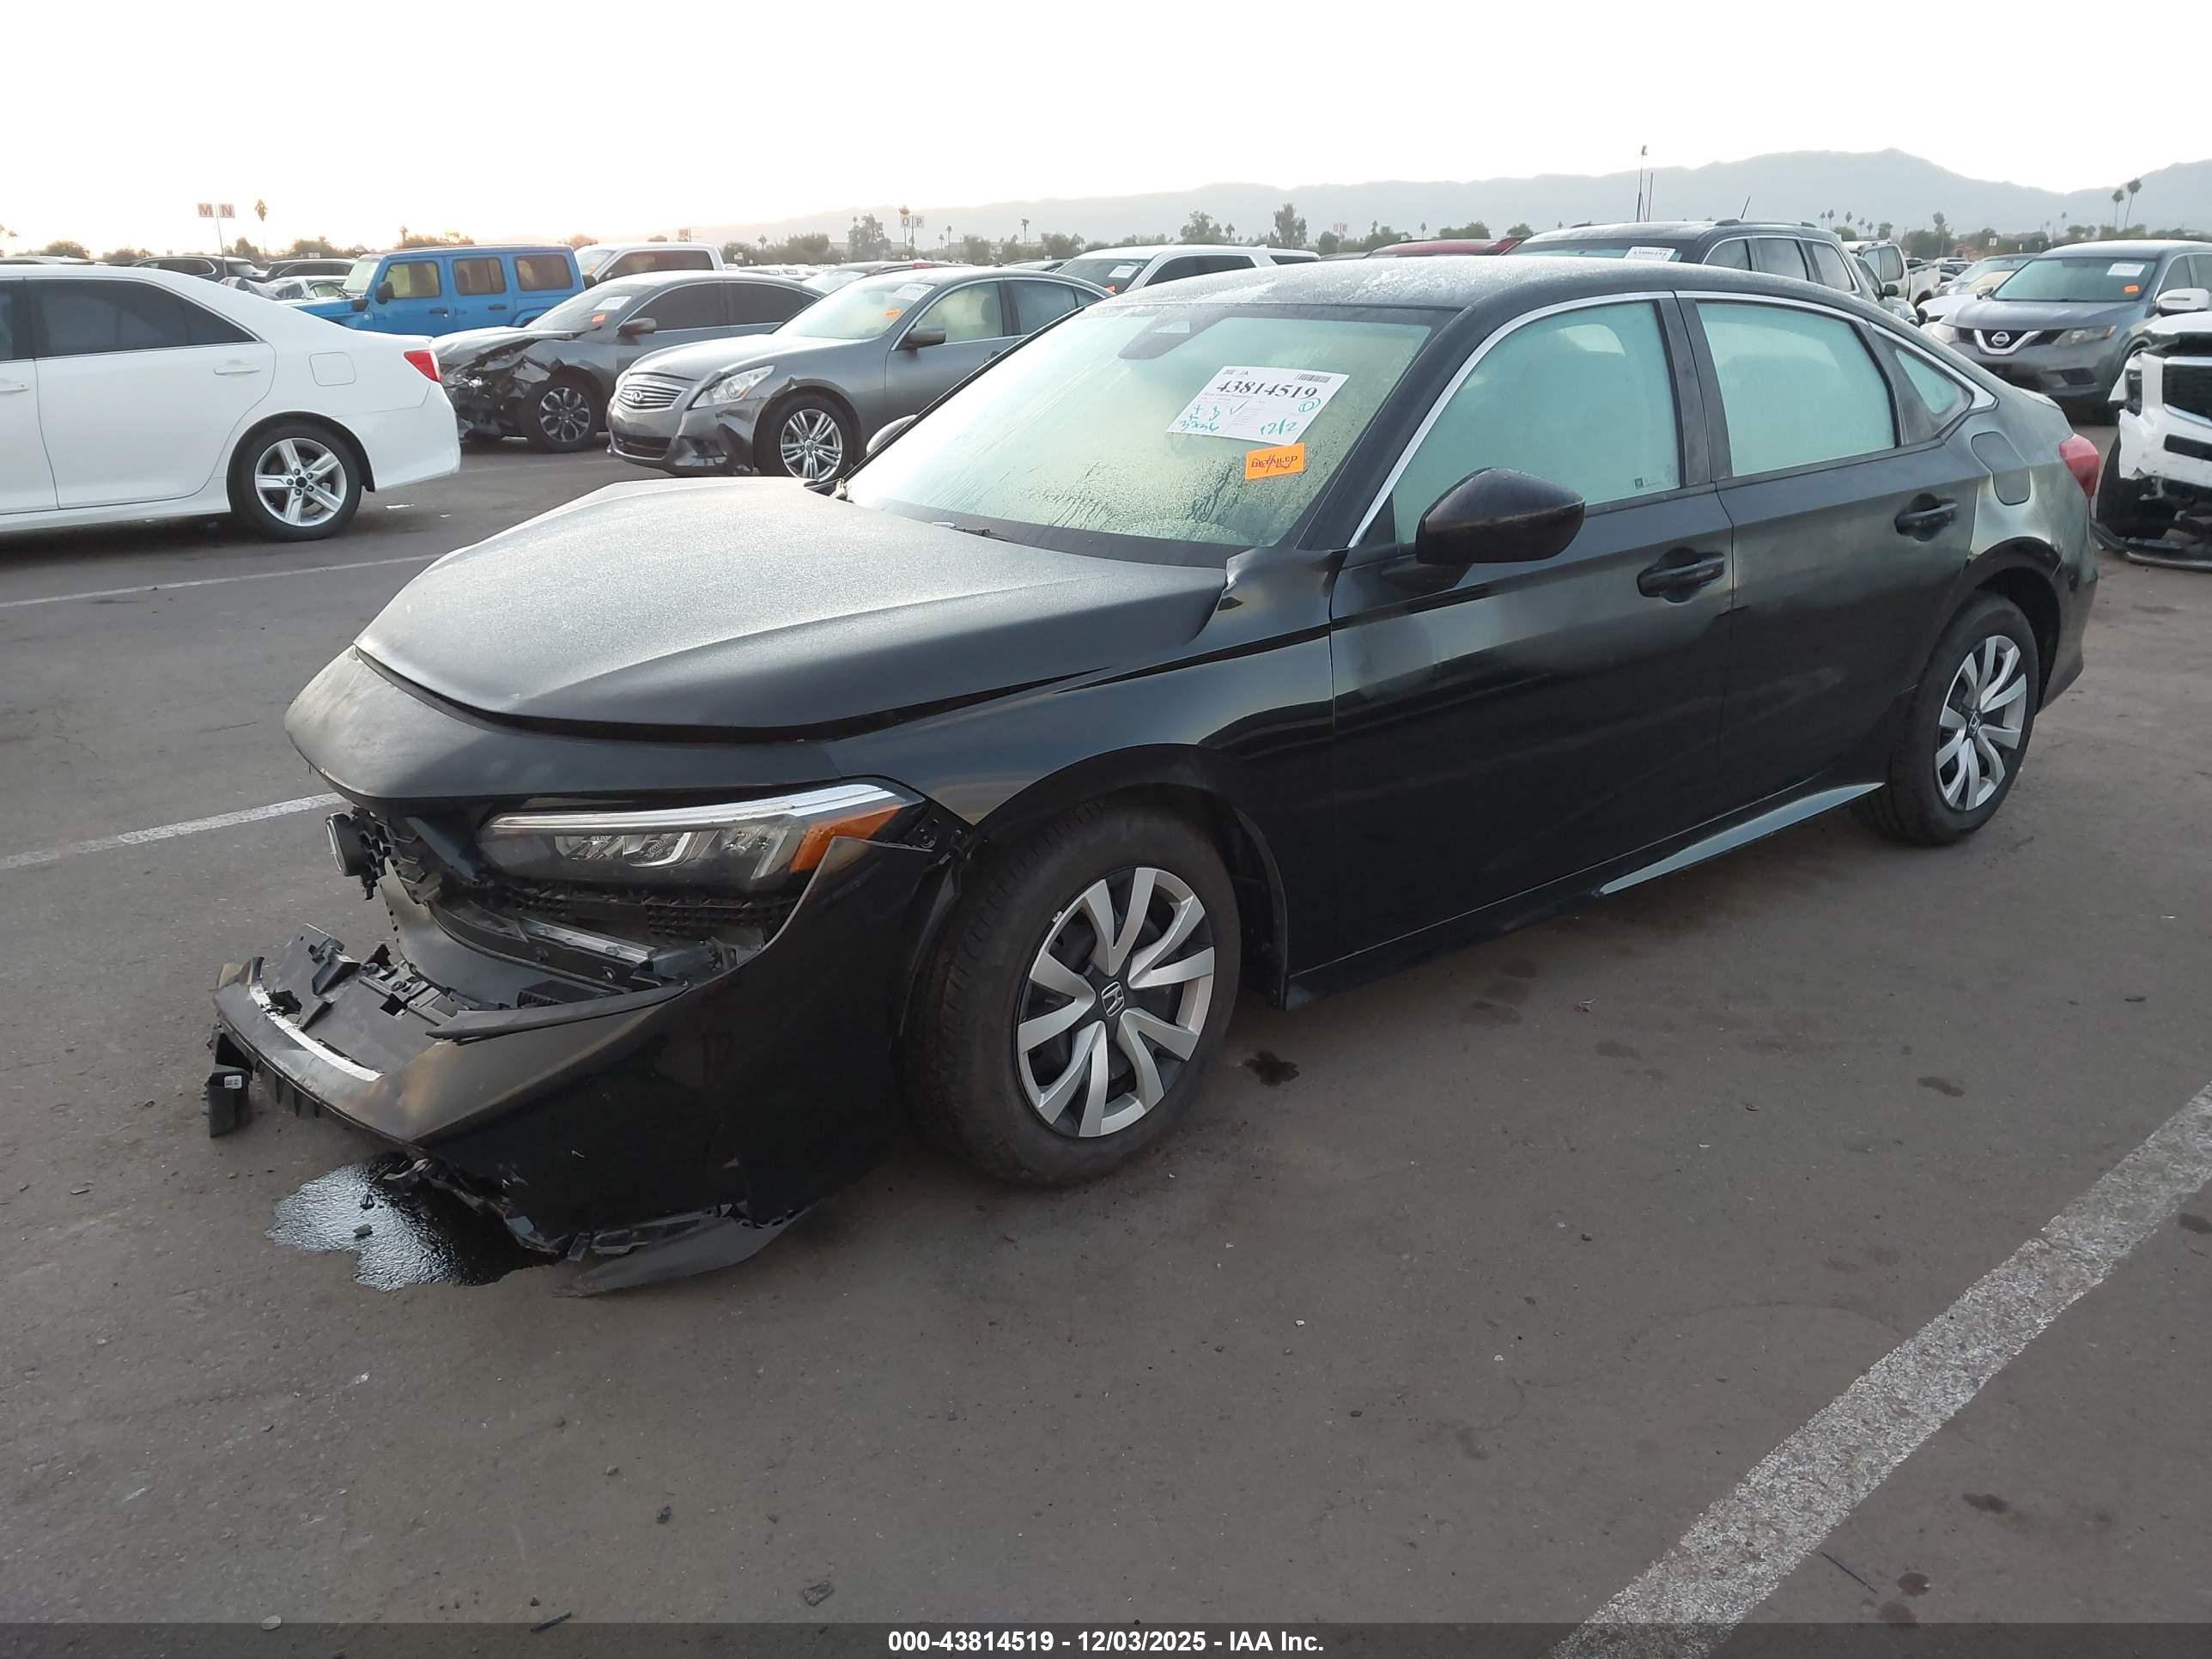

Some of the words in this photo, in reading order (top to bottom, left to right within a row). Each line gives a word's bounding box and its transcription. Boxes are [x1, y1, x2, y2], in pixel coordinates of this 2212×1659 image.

[198, 204, 213, 216] M
[221, 205, 233, 216] N
[1217, 380, 1318, 399] 43814519
